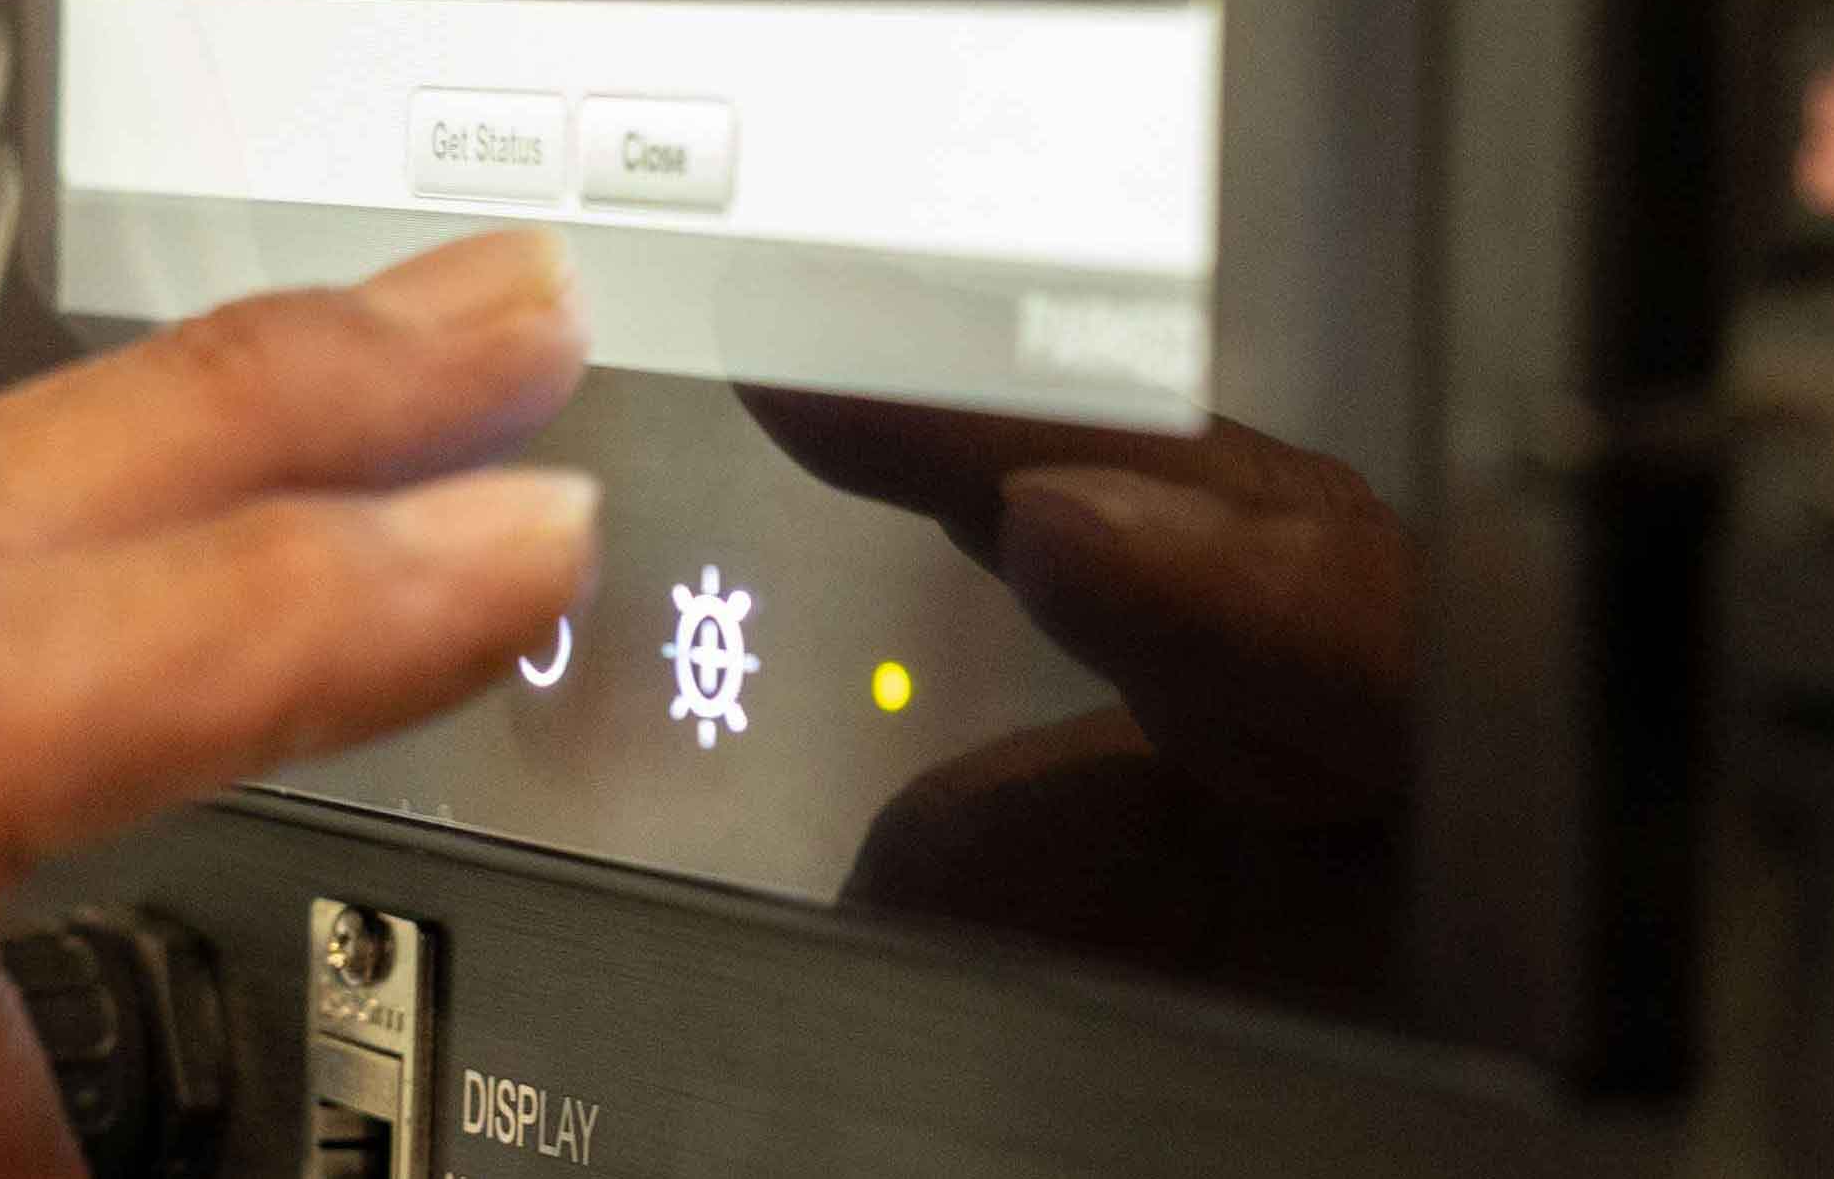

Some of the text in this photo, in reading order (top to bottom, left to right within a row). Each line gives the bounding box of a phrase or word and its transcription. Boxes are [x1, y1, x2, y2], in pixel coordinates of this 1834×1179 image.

[431, 121, 544, 167] Get Status
[623, 131, 688, 175] Close
[462, 1068, 600, 1167] DISPLAY
